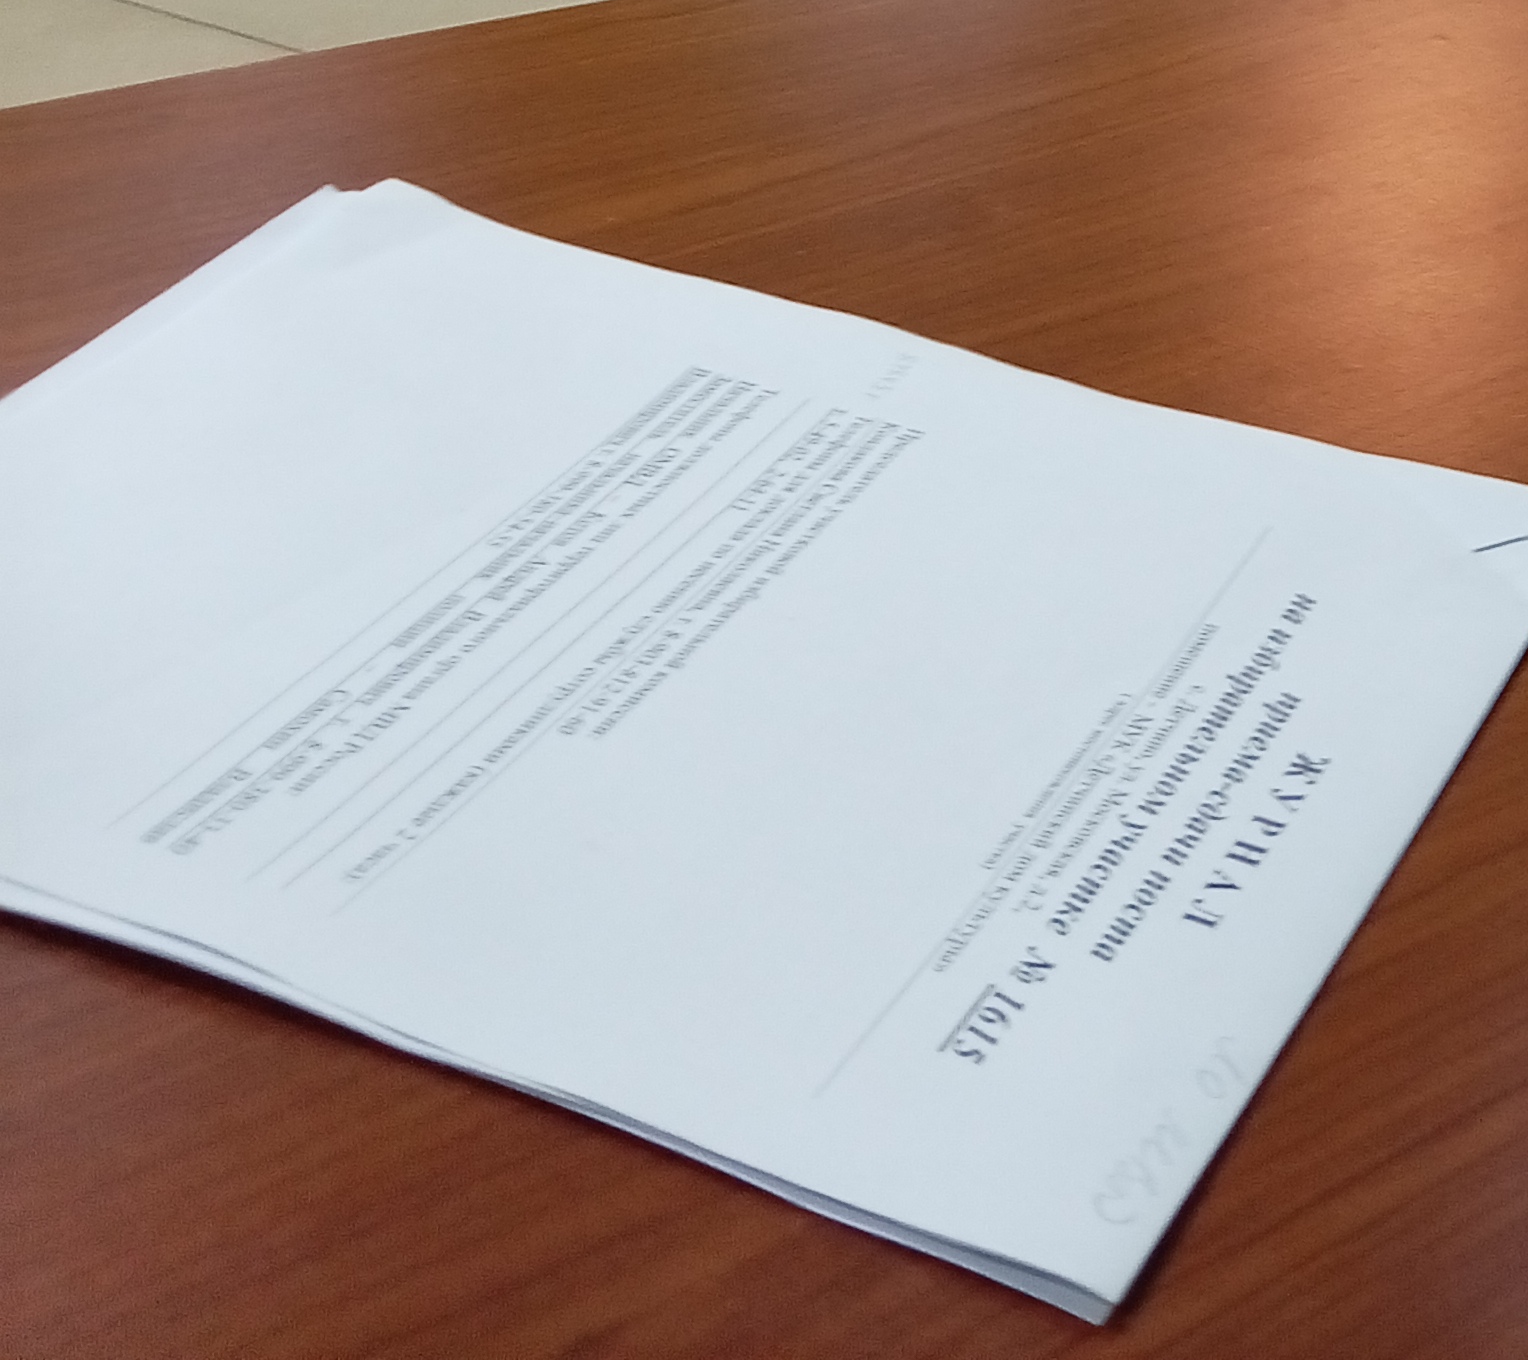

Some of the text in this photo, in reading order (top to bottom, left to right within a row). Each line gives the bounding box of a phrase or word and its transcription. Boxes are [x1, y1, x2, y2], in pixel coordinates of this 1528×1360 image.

[1106, 712, 1154, 754] МУК
[945, 590, 1321, 1066] на избирательном участке № 1615
[999, 850, 1040, 885] дом
[1086, 688, 1311, 964] приема-сдачи поста
[1180, 748, 1333, 931] ЖУРНАЛ
